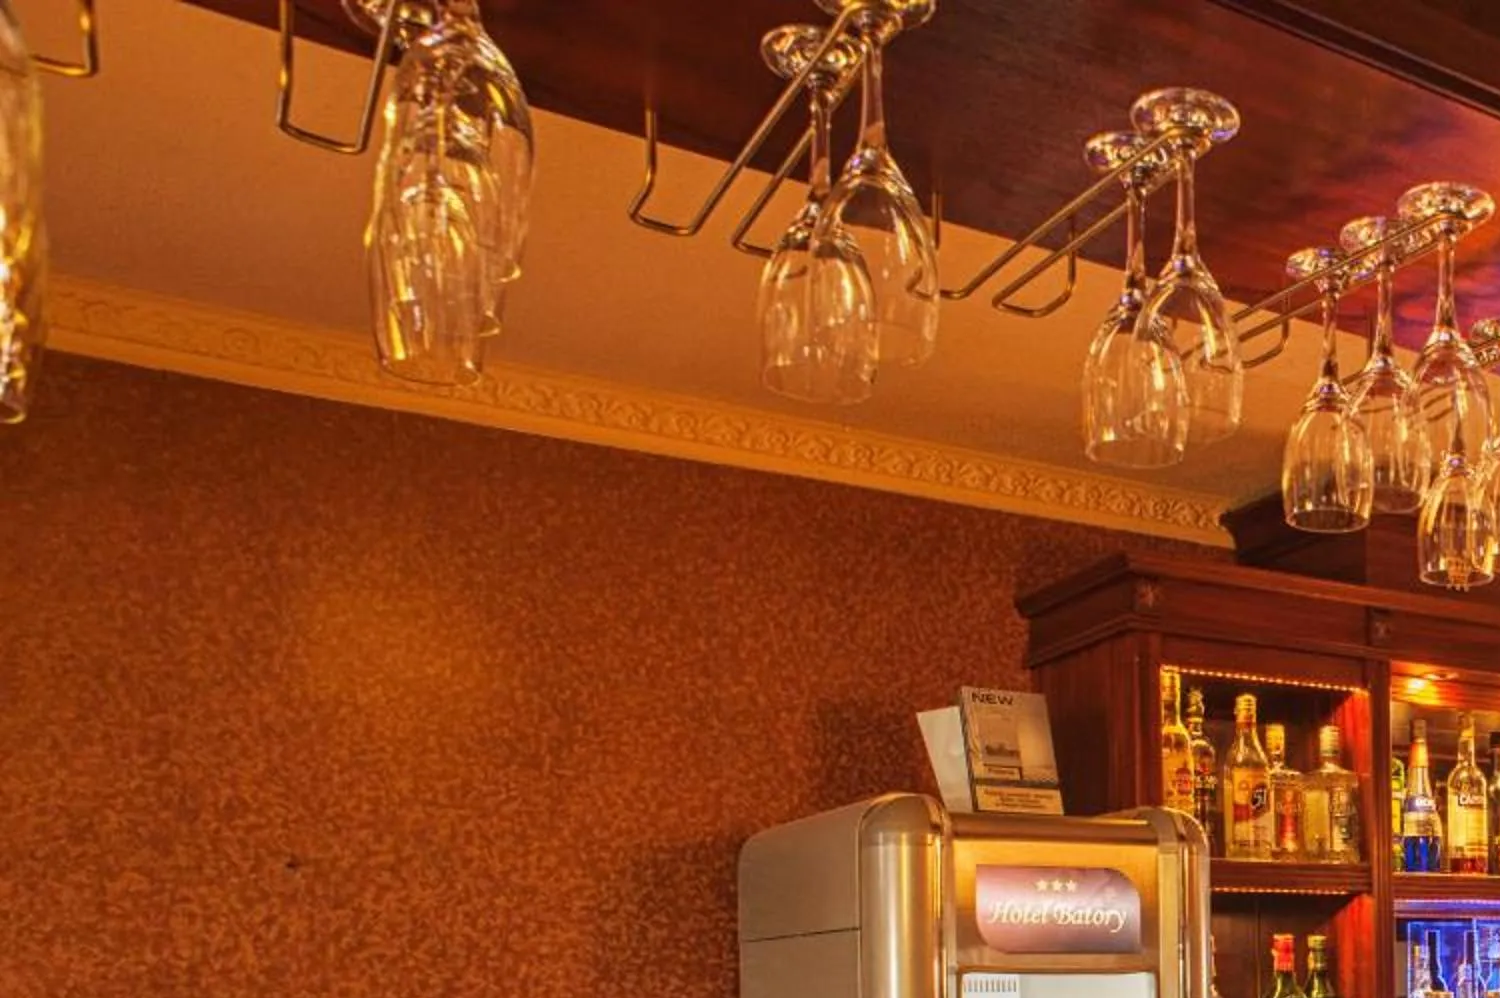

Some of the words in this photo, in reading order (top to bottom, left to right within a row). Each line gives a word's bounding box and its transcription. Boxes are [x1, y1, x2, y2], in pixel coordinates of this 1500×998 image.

[971, 692, 1014, 706] NEW
[988, 900, 1051, 924] Hotel
[1053, 903, 1127, 933] Batory
